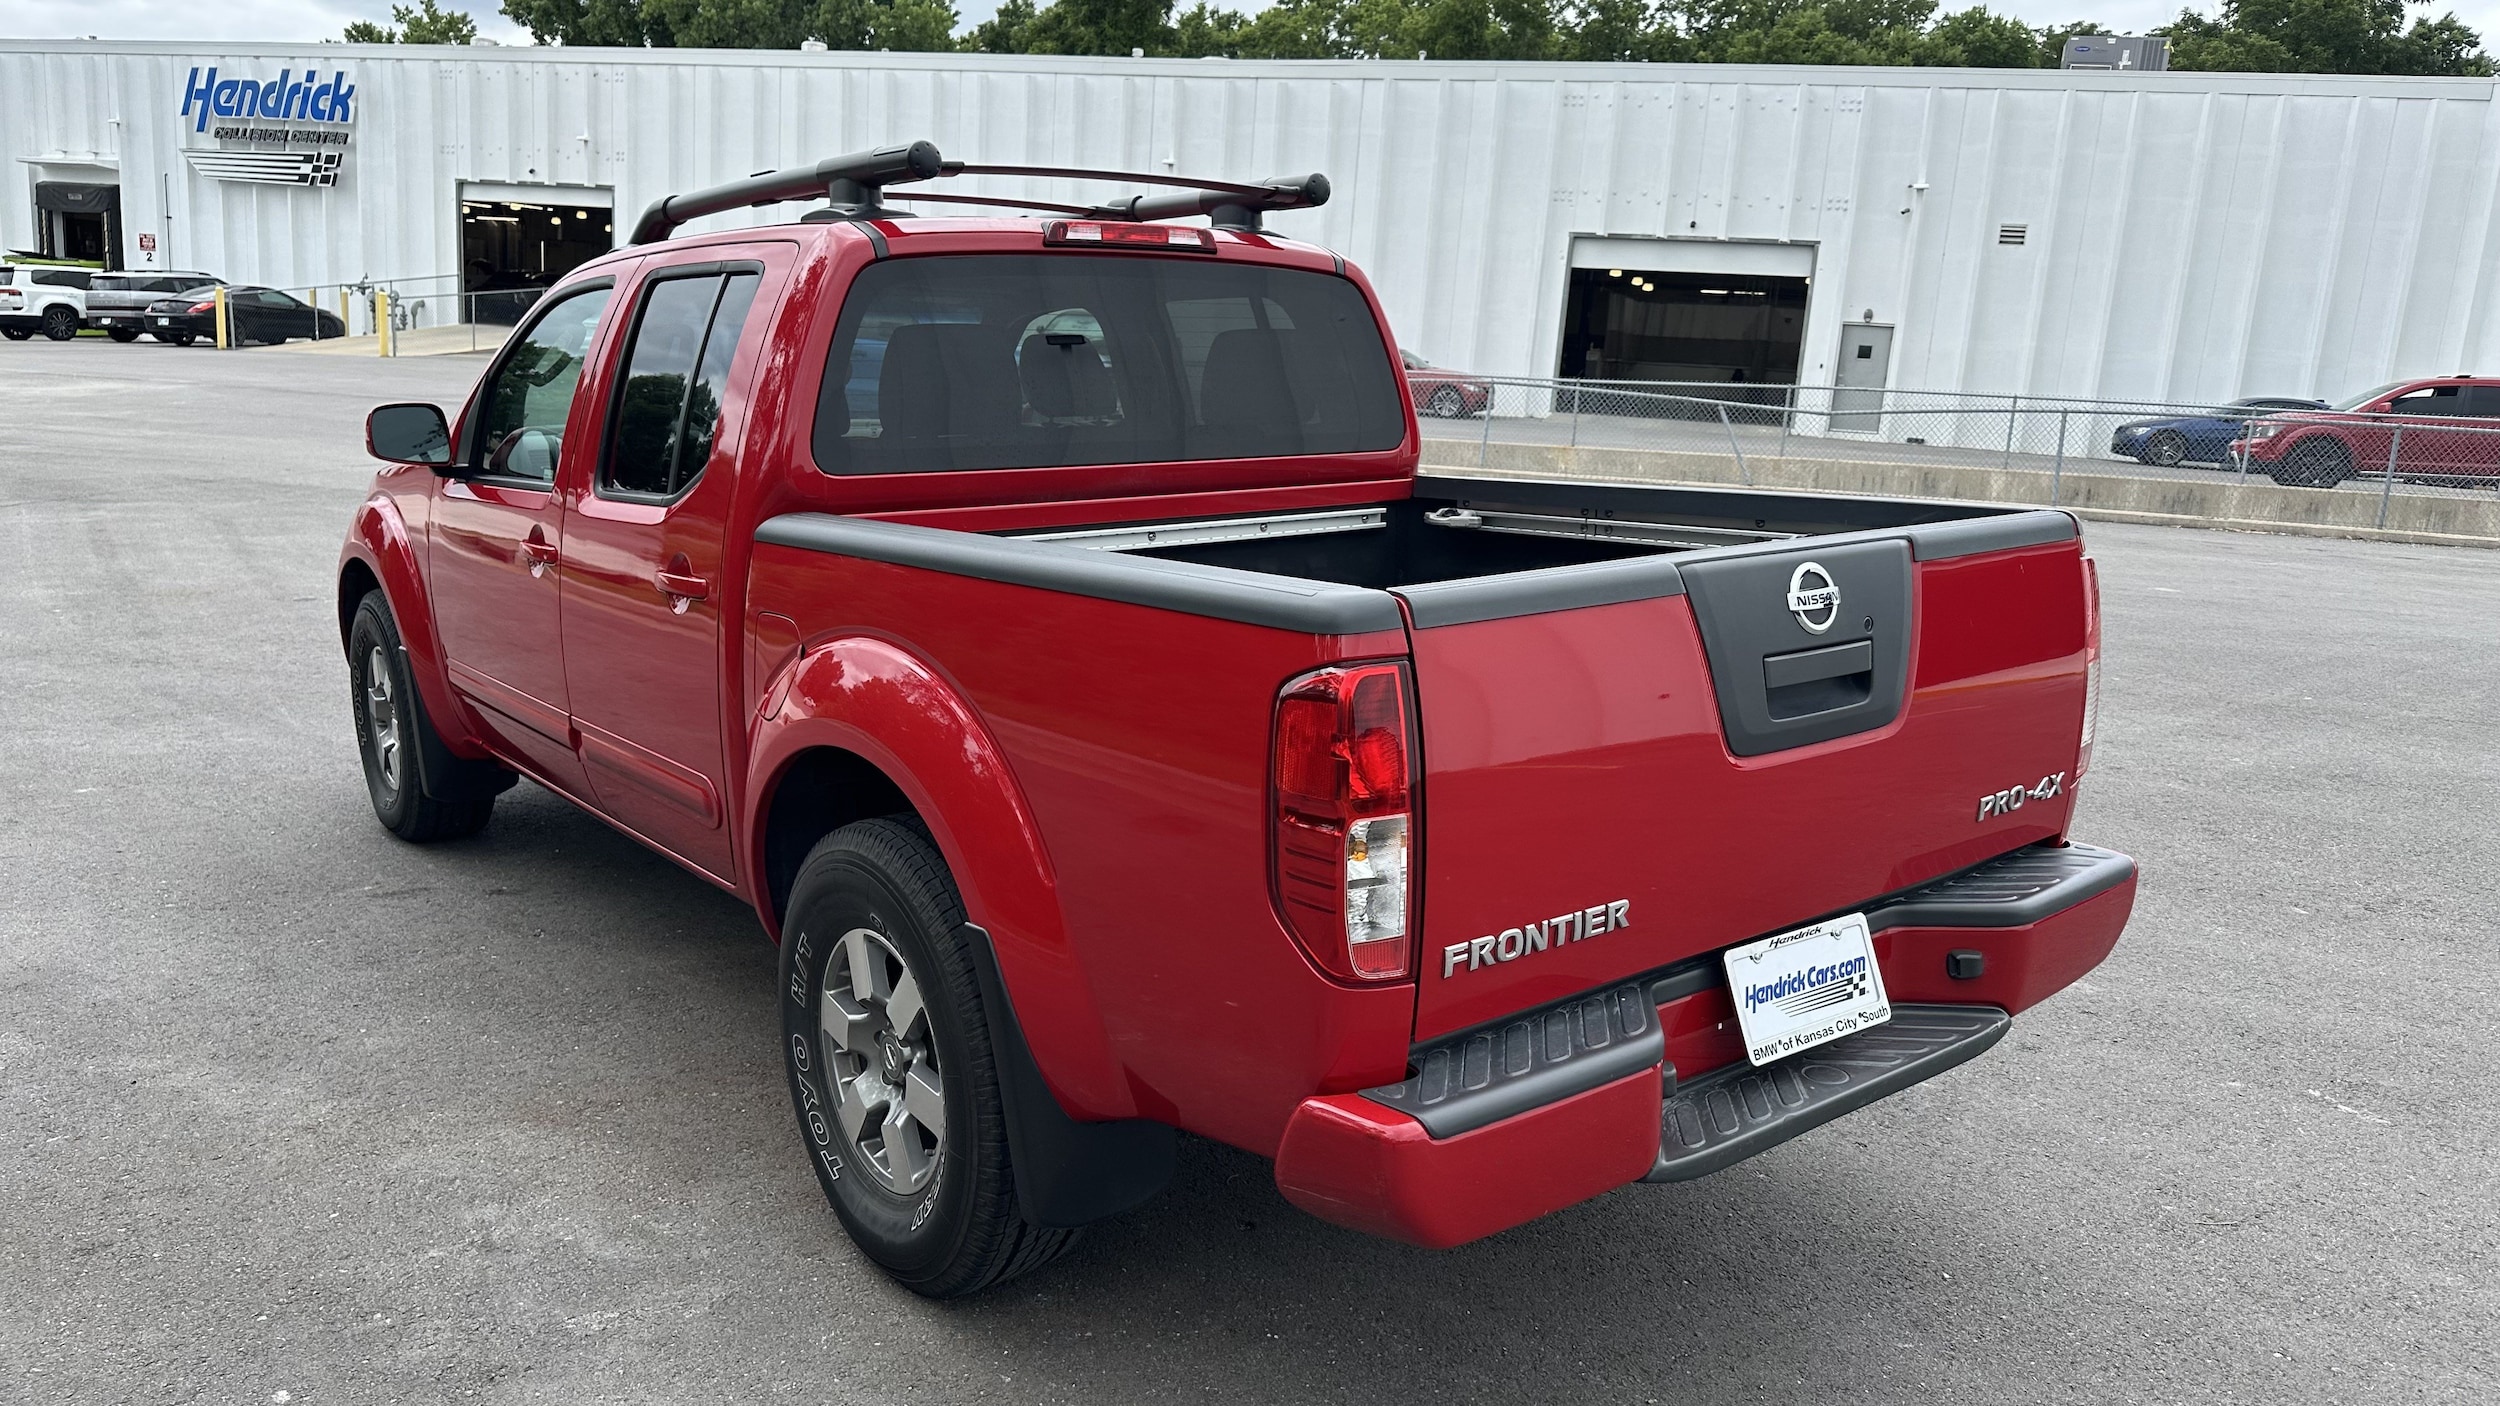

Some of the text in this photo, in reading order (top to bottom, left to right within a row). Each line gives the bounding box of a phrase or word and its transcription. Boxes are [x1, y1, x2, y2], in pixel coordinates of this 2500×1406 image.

[181, 66, 355, 133] Hendrick
[214, 127, 349, 145] COLLISION CENTER
[146, 252, 153, 261] 2
[1796, 591, 1838, 606] NISSAN
[1976, 771, 2065, 822] PRO-4X
[1443, 899, 1630, 979] FRONTIER
[1769, 926, 1822, 948] Hendrick
[791, 931, 844, 1180] TOYO H/T
[1753, 1005, 1889, 1060] BMW of Kansas City South
